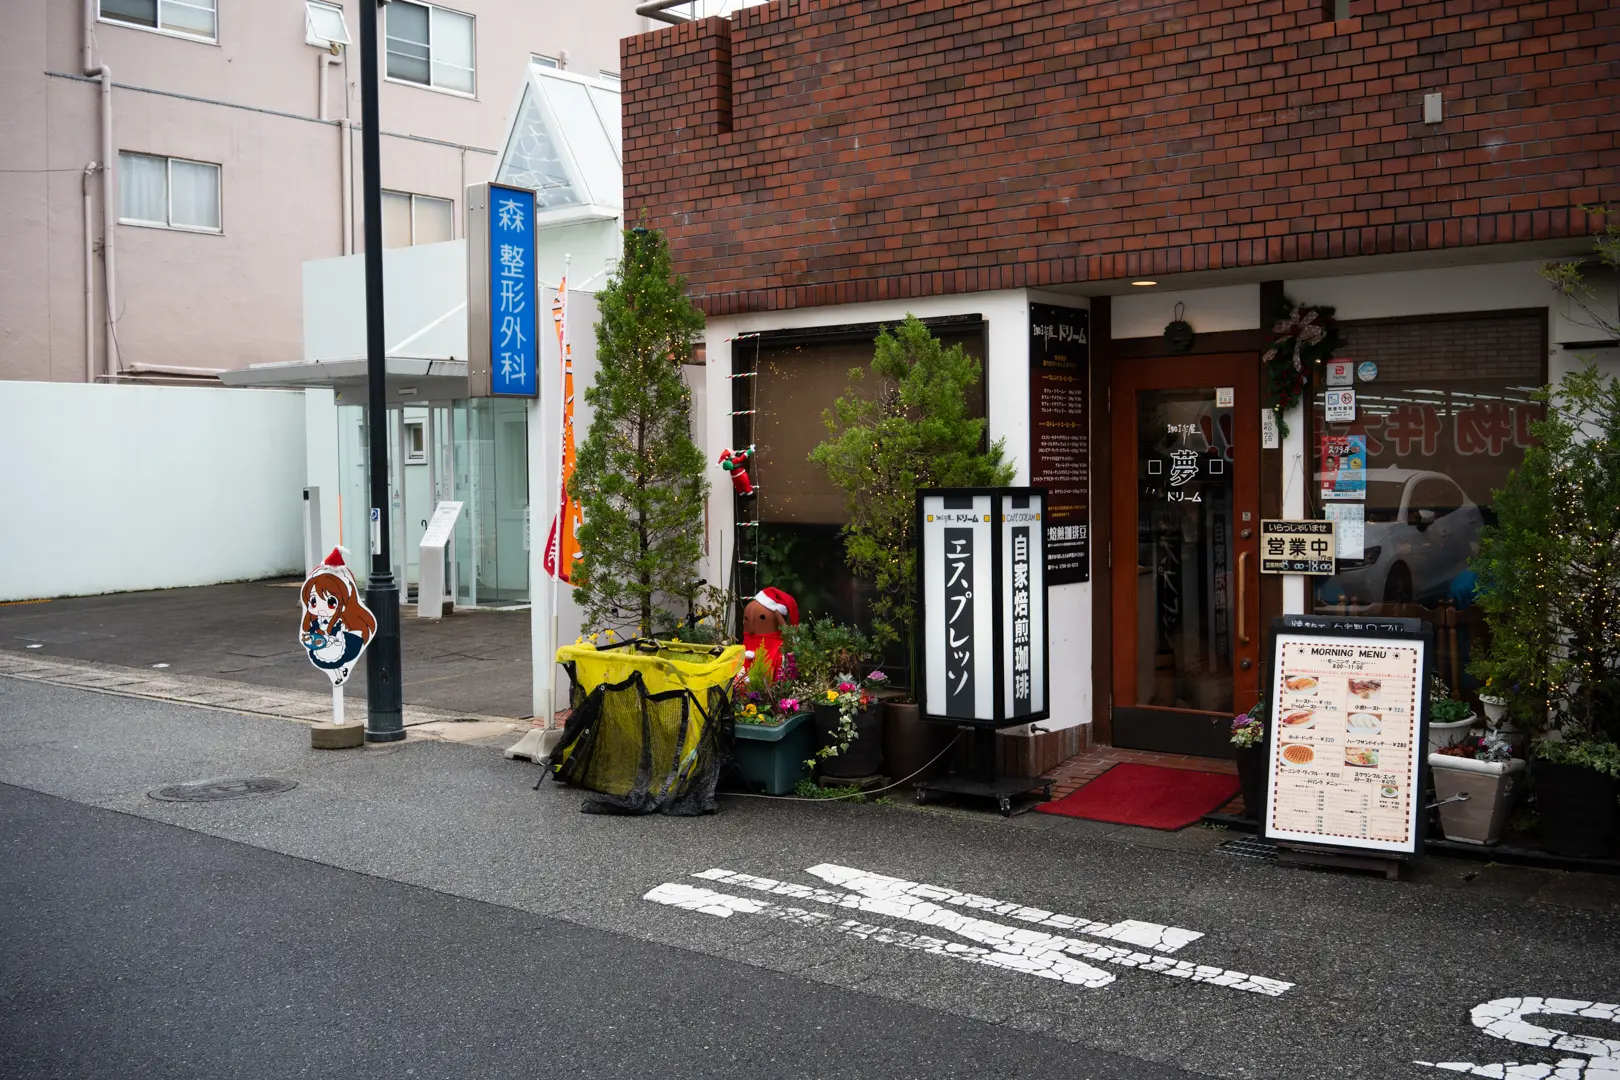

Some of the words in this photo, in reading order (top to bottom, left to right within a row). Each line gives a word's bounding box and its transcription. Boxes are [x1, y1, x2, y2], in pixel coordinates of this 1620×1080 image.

[498, 198, 525, 233] 森
[499, 244, 528, 386] 整形外科
[1059, 324, 1087, 344] ドリーム
[1170, 449, 1199, 487] 夢
[1167, 491, 1202, 502] ドリーム
[957, 514, 979, 523] ドリーム
[1019, 513, 1036, 522] DREAM
[1268, 523, 1327, 532] いらっしゃいませ
[1267, 537, 1328, 557] 営業中
[946, 539, 973, 696] エスプレッソ
[1013, 534, 1029, 700] 自家焙煎珈琲
[1310, 647, 1354, 657] MORNING
[1358, 650, 1387, 659] MENU
